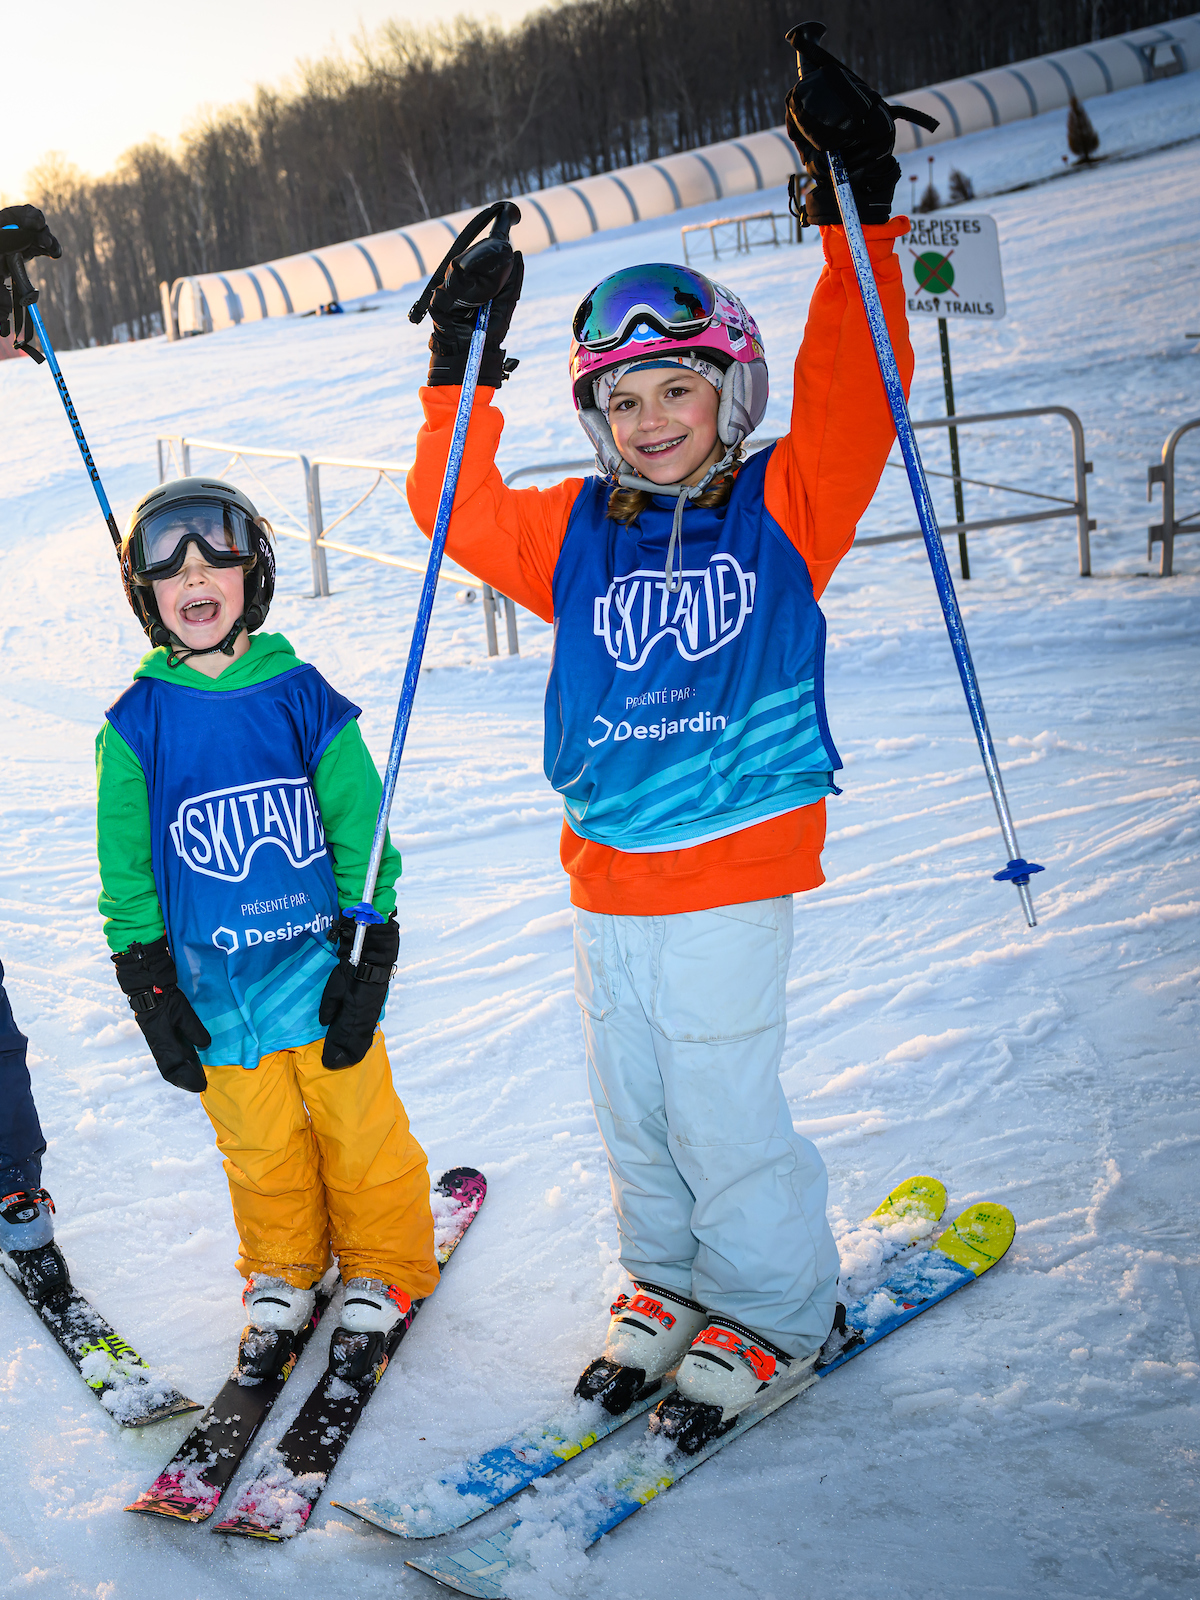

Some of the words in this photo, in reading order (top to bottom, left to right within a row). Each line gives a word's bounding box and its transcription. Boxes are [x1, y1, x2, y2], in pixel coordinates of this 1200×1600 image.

[929, 219, 981, 234] PISTES
[901, 231, 959, 246] FACILES
[908, 298, 940, 312] EASY
[944, 300, 994, 316] TRAILS
[671, 686, 690, 702] PAR
[614, 711, 729, 742] Desjardin
[240, 893, 289, 917] PRÉSENTÉ
[290, 892, 306, 908] PAR
